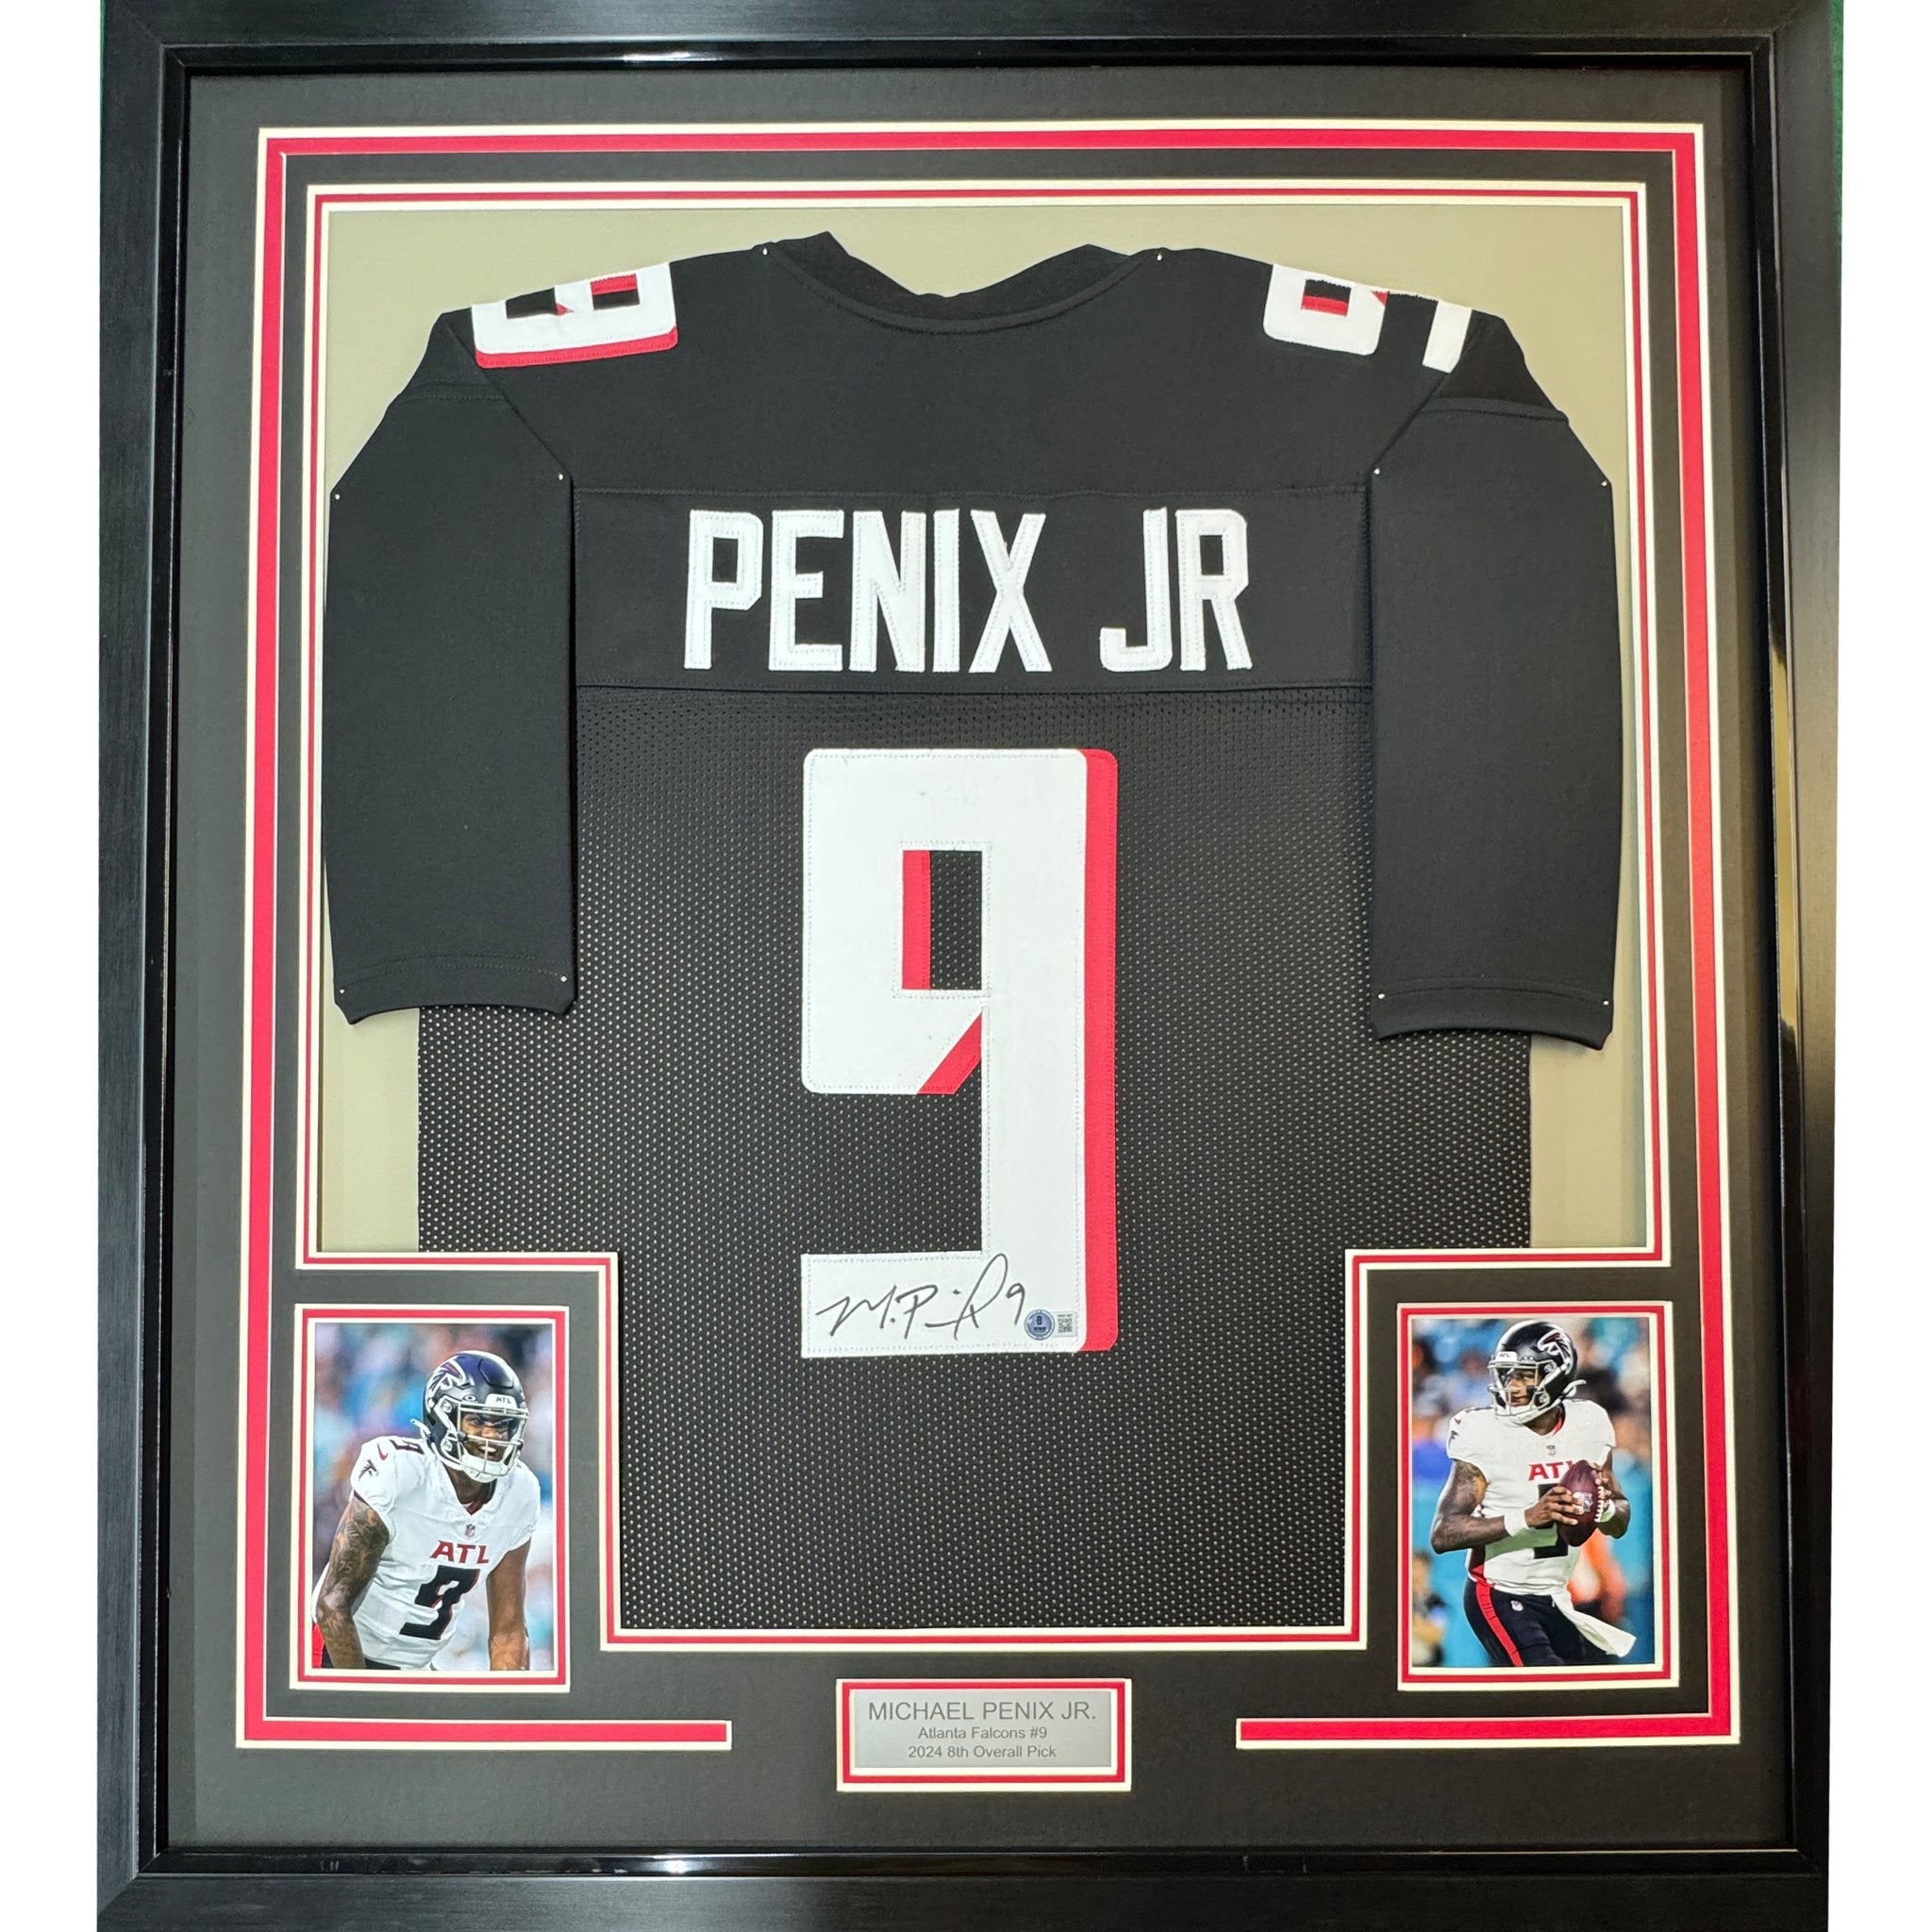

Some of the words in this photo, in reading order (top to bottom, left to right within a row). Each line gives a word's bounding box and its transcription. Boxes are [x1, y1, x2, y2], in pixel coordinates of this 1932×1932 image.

[684, 509, 1053, 673] PENIX
[1099, 507, 1253, 672] JR
[801, 747, 1119, 1358] 9
[430, 1540, 489, 1564] ATL
[399, 1564, 480, 1641] 9
[869, 1702, 974, 1721] MICHAEL
[983, 1701, 1055, 1720] PENIX
[1061, 1701, 1096, 1720] JR.
[918, 1726, 967, 1740] Atlanta
[972, 1726, 1025, 1740] Falcons
[1029, 1726, 1048, 1740] #9
[908, 1745, 942, 1757] 2024
[947, 1745, 969, 1758] 8th
[974, 1745, 1023, 1758] Overall
[1027, 1745, 1057, 1757] Pick
